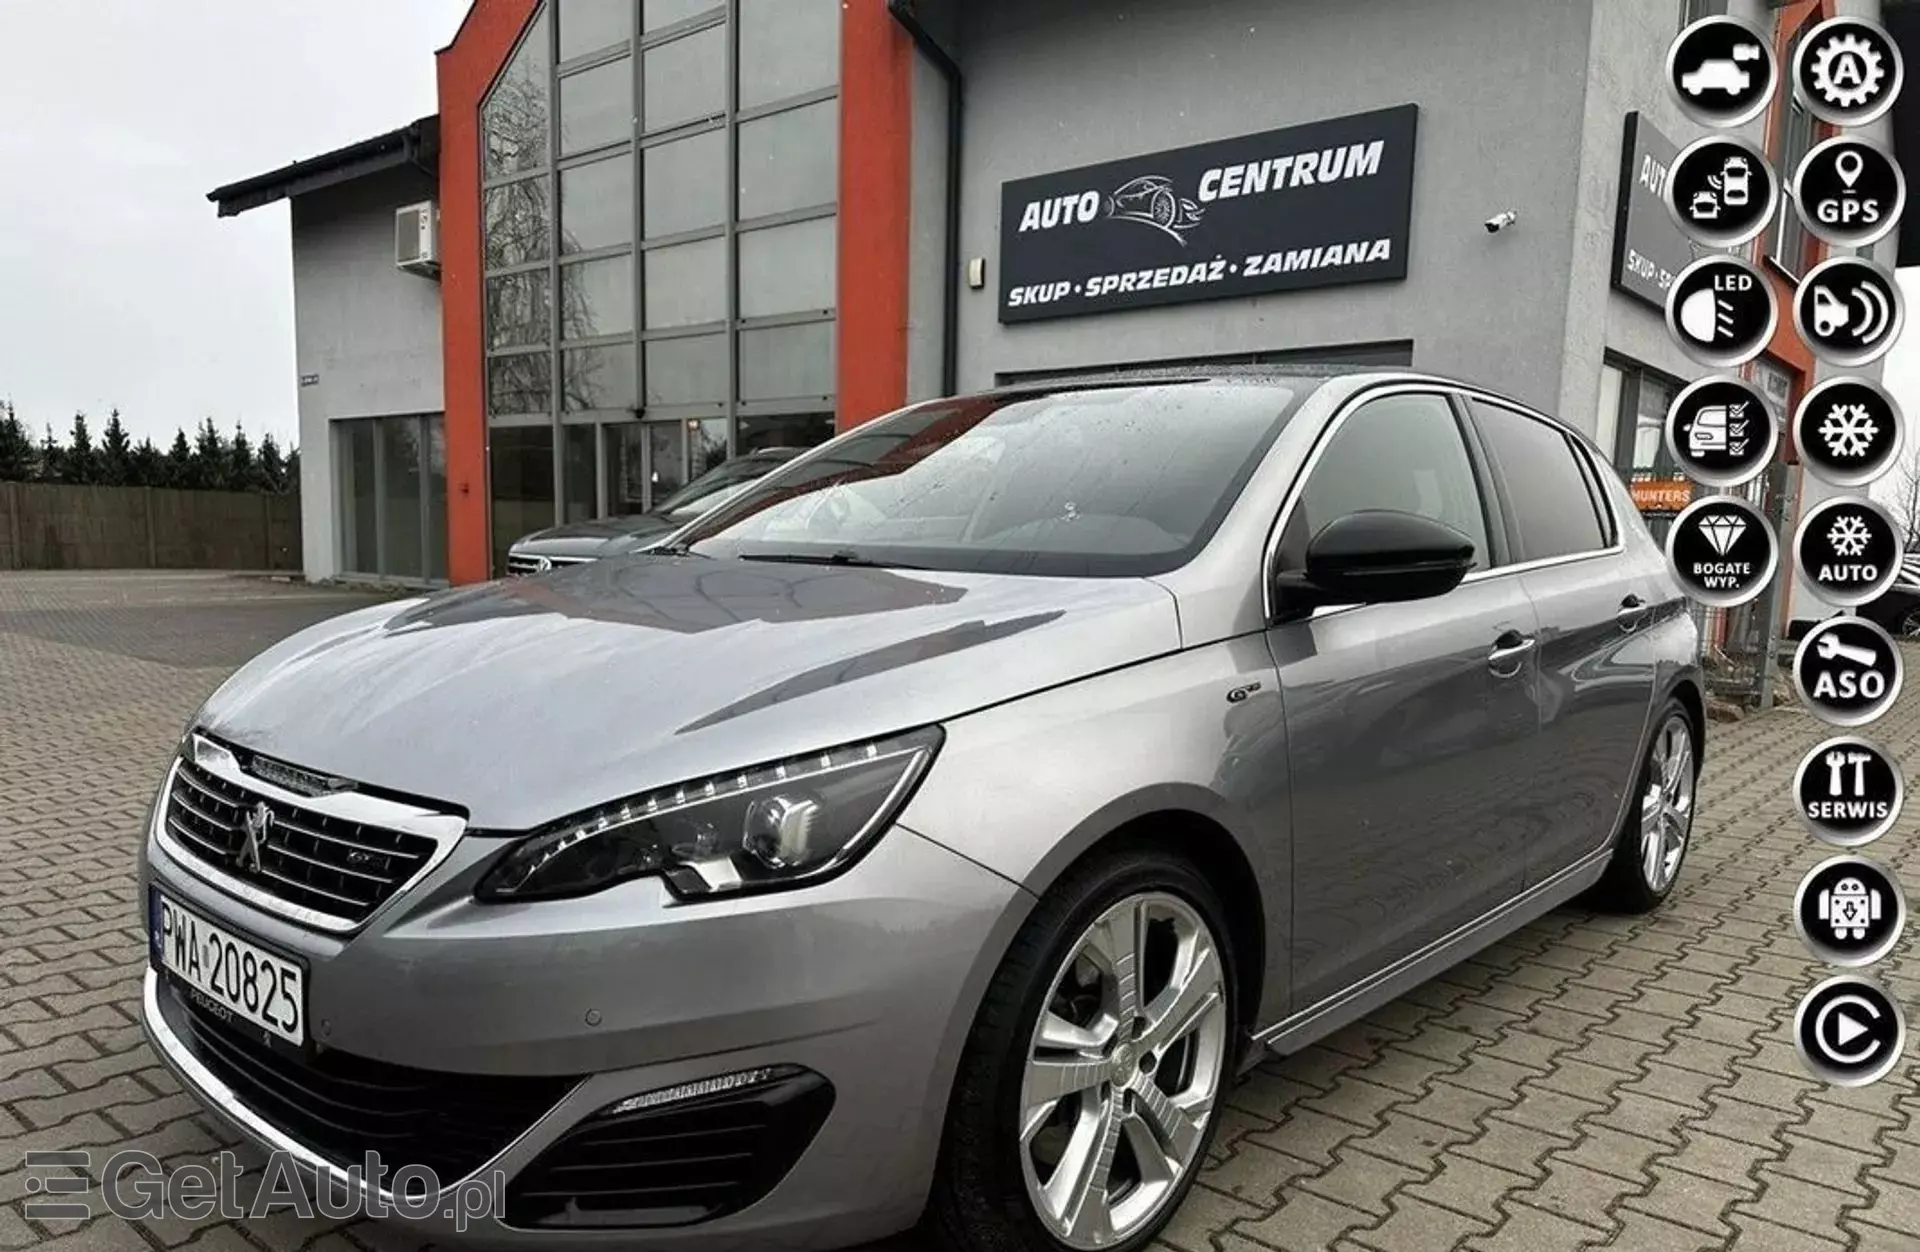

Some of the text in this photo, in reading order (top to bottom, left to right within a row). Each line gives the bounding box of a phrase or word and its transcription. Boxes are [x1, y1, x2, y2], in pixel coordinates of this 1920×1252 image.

[1019, 140, 1386, 232] AUTO CENTRUM
[1008, 238, 1391, 307] SKUP SPRZEDAŻ ZAMIANA
[162, 900, 298, 1034] PWA 20825
